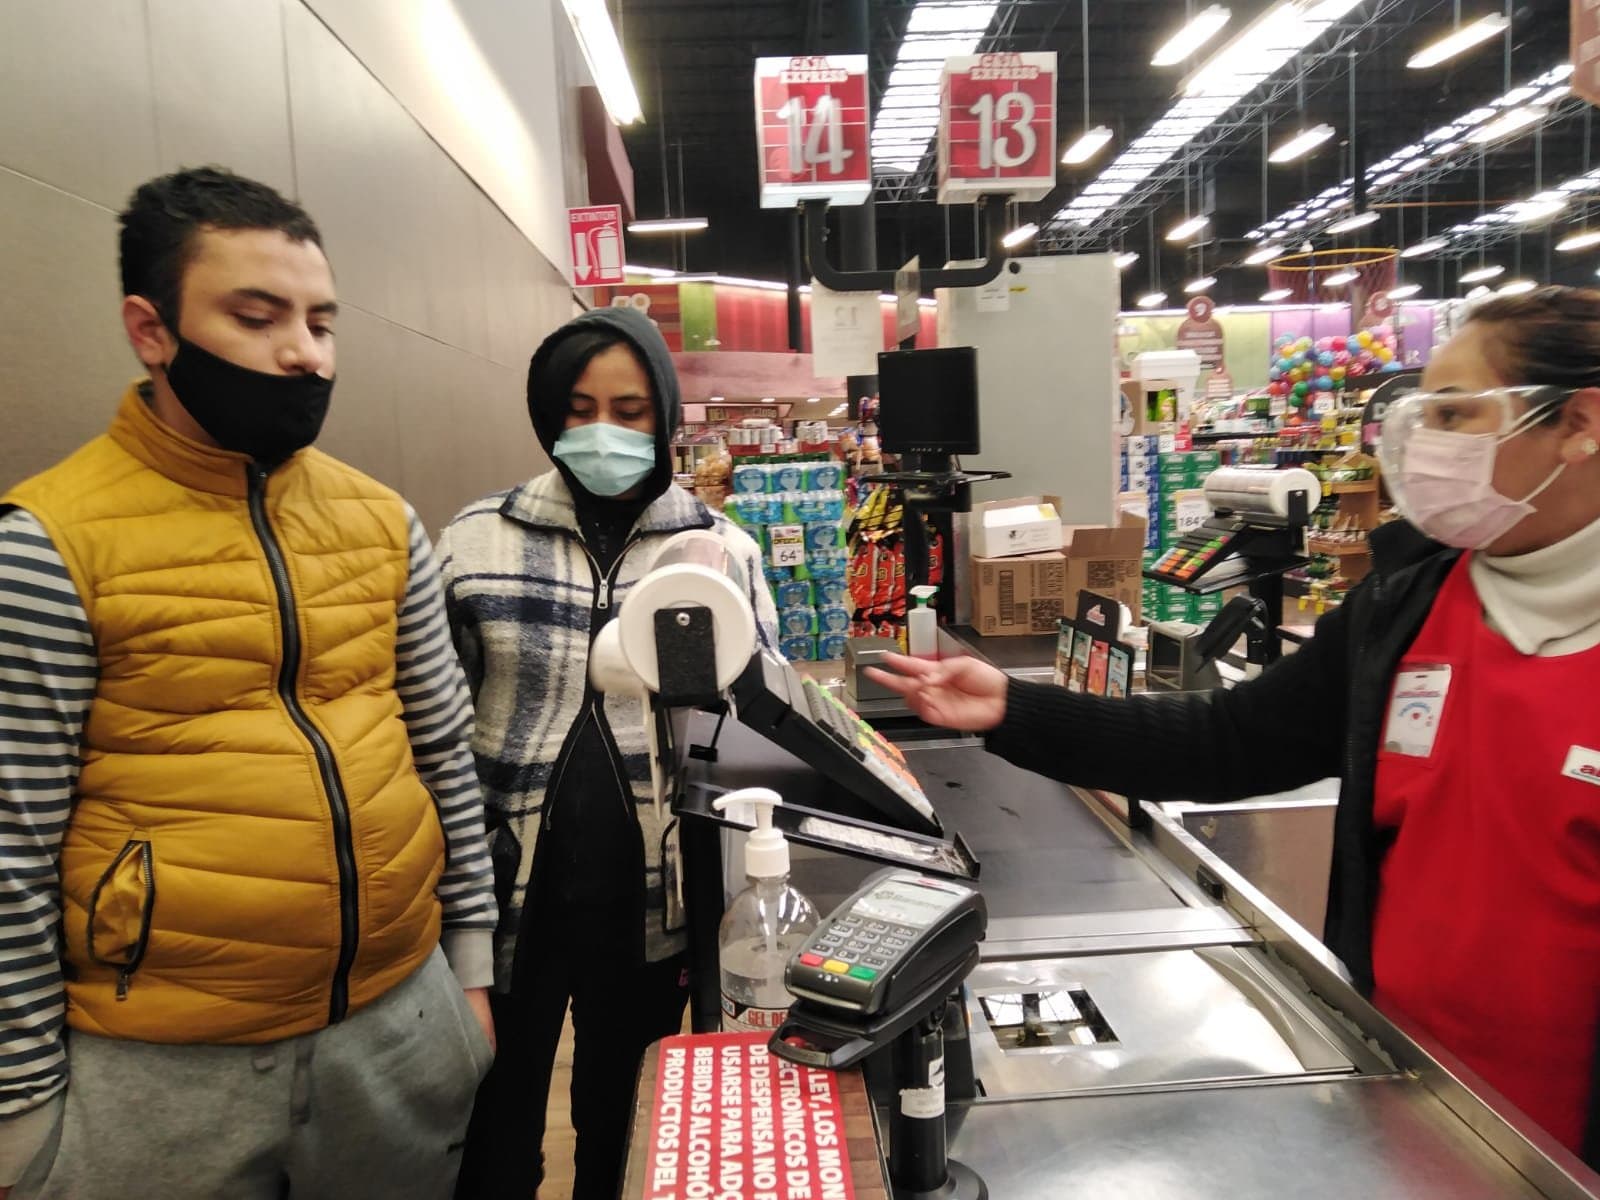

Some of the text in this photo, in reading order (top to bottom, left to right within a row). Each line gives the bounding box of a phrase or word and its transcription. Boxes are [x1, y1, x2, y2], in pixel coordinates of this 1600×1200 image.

[781, 70, 847, 83] EXPRESS
[970, 67, 1038, 80] EXPRESS
[777, 95, 853, 175] 14
[969, 92, 1036, 170] 13
[780, 550, 797, 562] 64
[748, 1010, 765, 1028] GEL
[749, 1044, 769, 1064] DE
[721, 1046, 742, 1106] USARSE
[808, 1074, 832, 1109] LEY,
[657, 1048, 686, 1150] PRODUCTOS
[750, 1066, 775, 1155] DESPENSA
[686, 1046, 715, 1200] BEBIDAS ALCOHÓ
[720, 1108, 743, 1158] PARA
[778, 1055, 812, 1200] ECTRÓNICOS DE
[813, 1111, 838, 1147] LOS
[653, 1152, 679, 1192] DEL
[753, 1157, 776, 1189] NO
